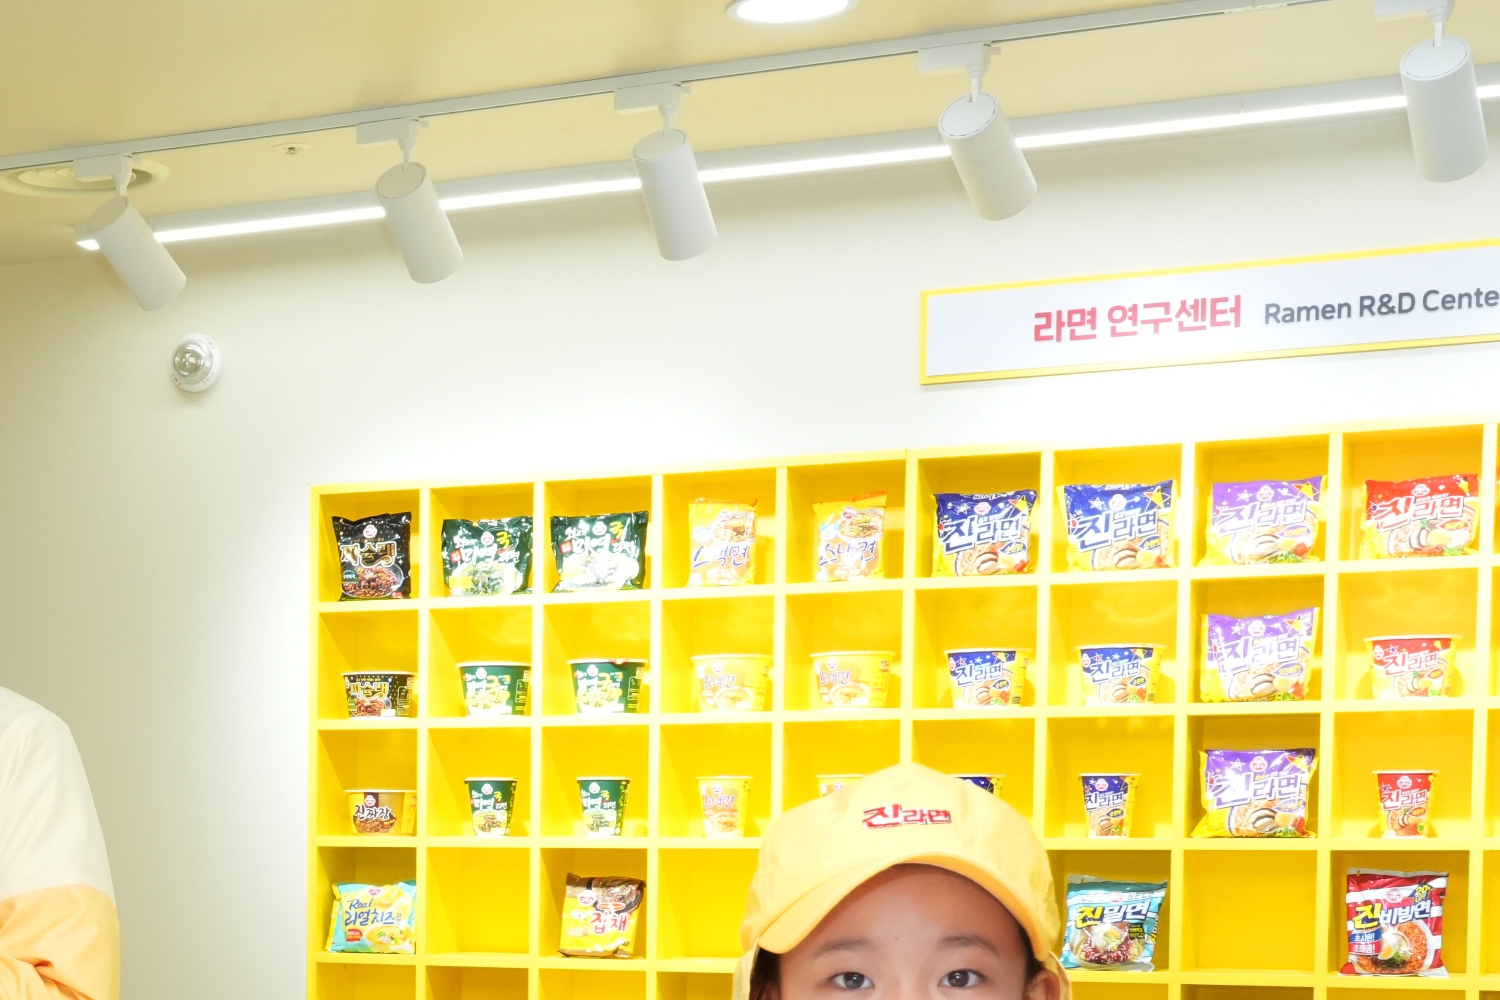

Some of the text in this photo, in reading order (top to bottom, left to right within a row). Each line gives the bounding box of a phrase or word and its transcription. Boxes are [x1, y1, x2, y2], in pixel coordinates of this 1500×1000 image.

[1034, 294, 1242, 343] 라면 연구센터
[1264, 298, 1352, 326] Ramen
[1358, 291, 1416, 318] R&D
[1217, 499, 1308, 536] 진라면
[1372, 496, 1465, 532] 진라면
[941, 514, 1023, 555] 진라면
[1074, 509, 1158, 552] 진라면
[341, 541, 397, 567] 짜슐랭
[1216, 635, 1300, 674] 진라면
[1383, 650, 1439, 676] 진라면
[955, 663, 1003, 687] 진라면
[1090, 660, 1141, 684] 진라면
[1085, 792, 1124, 811] 진라면
[1213, 772, 1301, 808] 진라면
[1380, 789, 1427, 810] 진라면
[355, 804, 391, 820] 진짜장
[862, 804, 952, 829] 진라면
[345, 908, 395, 926] 리얼치즈
[1075, 901, 1151, 929] 진밀면
[1353, 899, 1431, 930] 진비빔면
